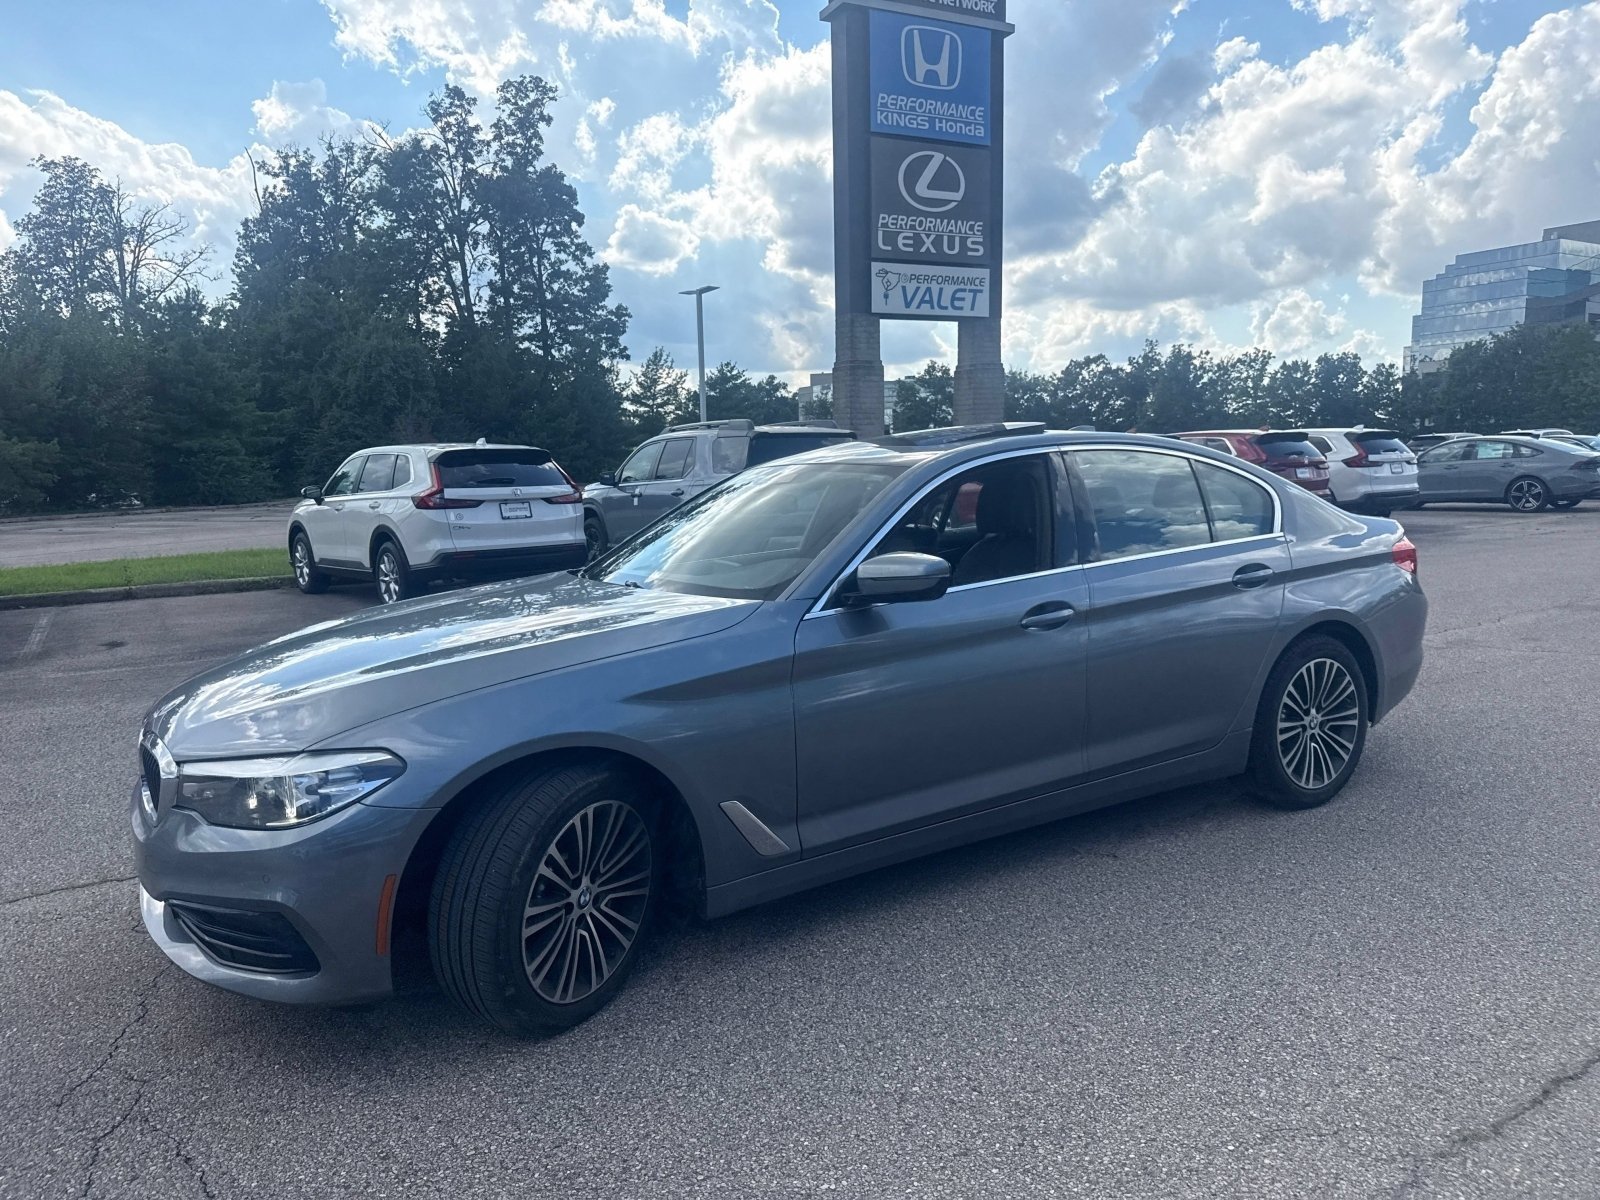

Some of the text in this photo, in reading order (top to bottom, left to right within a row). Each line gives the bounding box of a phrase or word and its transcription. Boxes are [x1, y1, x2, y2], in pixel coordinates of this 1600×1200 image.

[877, 92, 985, 120] PERFORMANCE
[877, 111, 985, 137] KINGS Honda
[878, 213, 984, 235] PERFORMANCE
[877, 230, 985, 256] LEXUS
[908, 273, 986, 287] PERFORMANCE
[901, 285, 984, 311] VALET
